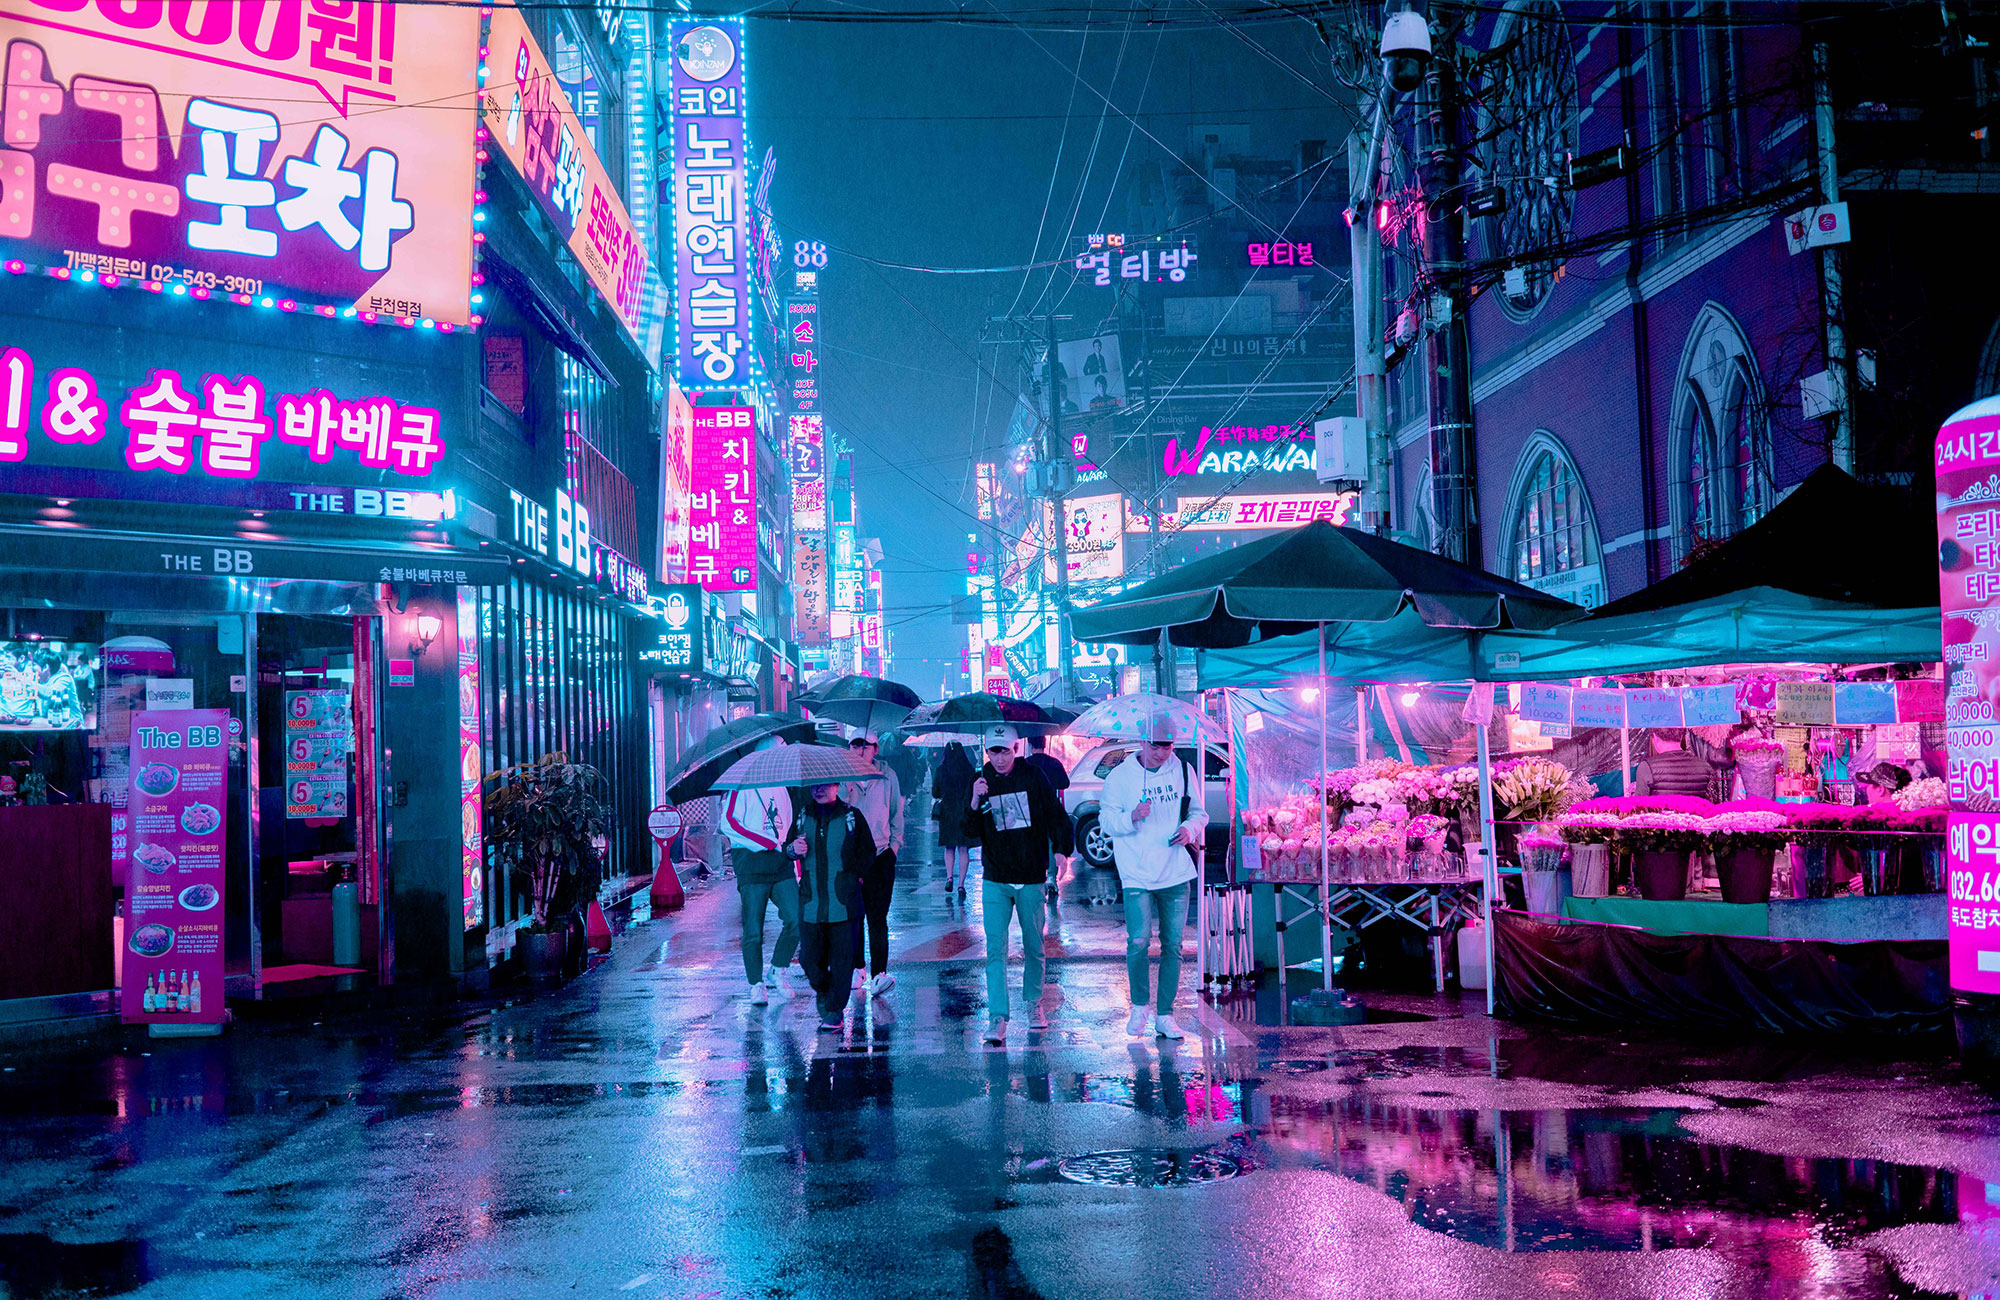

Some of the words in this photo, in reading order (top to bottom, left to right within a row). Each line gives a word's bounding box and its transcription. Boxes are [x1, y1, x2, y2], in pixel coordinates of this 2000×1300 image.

[679, 87, 737, 115] 코인
[686, 122, 742, 382] 노래연습장
[794, 240, 828, 268] 88
[1248, 242, 1314, 266] 멀티방
[64, 250, 147, 280] 가맹점문의
[151, 264, 262, 296] 02-543-3901
[1076, 249, 1198, 286] 멀티방
[369, 297, 422, 317] 부천역점
[789, 304, 816, 314] ROOM
[128, 378, 267, 472] 숯불
[282, 395, 440, 470] 바베큐
[716, 411, 752, 428] BB
[721, 436, 750, 503] 치킨
[290, 491, 345, 513] THE
[1235, 498, 1340, 524] 포차끝판왕
[509, 487, 548, 557] THE
[555, 485, 591, 578] BB
[690, 488, 721, 584] 바베큐
[161, 553, 202, 571] THE
[213, 548, 254, 574] BB
[379, 565, 468, 585] 숯불바베큐전문
[731, 569, 750, 583] 1F
[296, 697, 307, 718] 5
[138, 726, 181, 748] The
[187, 726, 221, 747] BB
[296, 739, 307, 760] 5
[296, 782, 307, 803] 5
